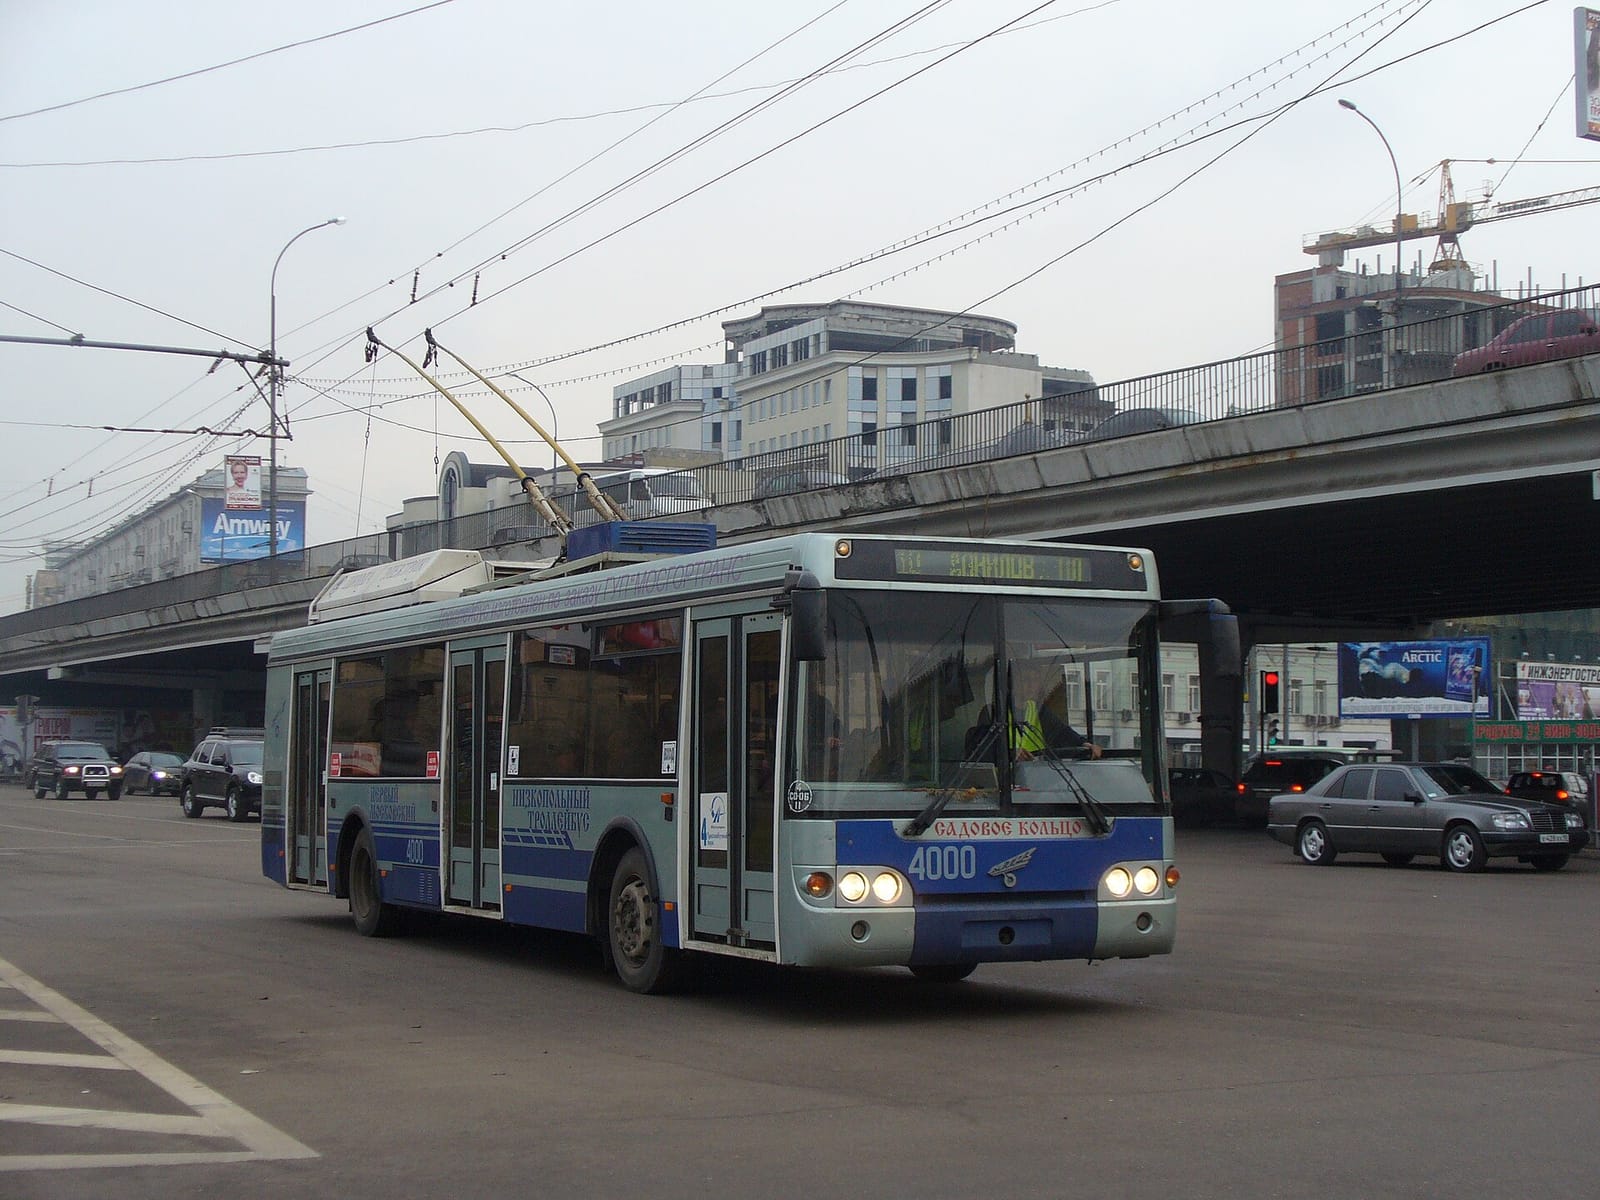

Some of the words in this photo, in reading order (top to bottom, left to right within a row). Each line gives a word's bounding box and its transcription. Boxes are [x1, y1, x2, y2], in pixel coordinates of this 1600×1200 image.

[213, 512, 291, 540] Amway
[512, 787, 591, 809] НИЗКОПОЛЬНЫЙ
[528, 809, 590, 838] ТРОЛЛЕЙБУС
[934, 821, 1013, 838] САДОВОЕ
[1018, 820, 1082, 838] КОЛЬЦО
[406, 839, 424, 864] 4000
[908, 845, 977, 881] 4000
